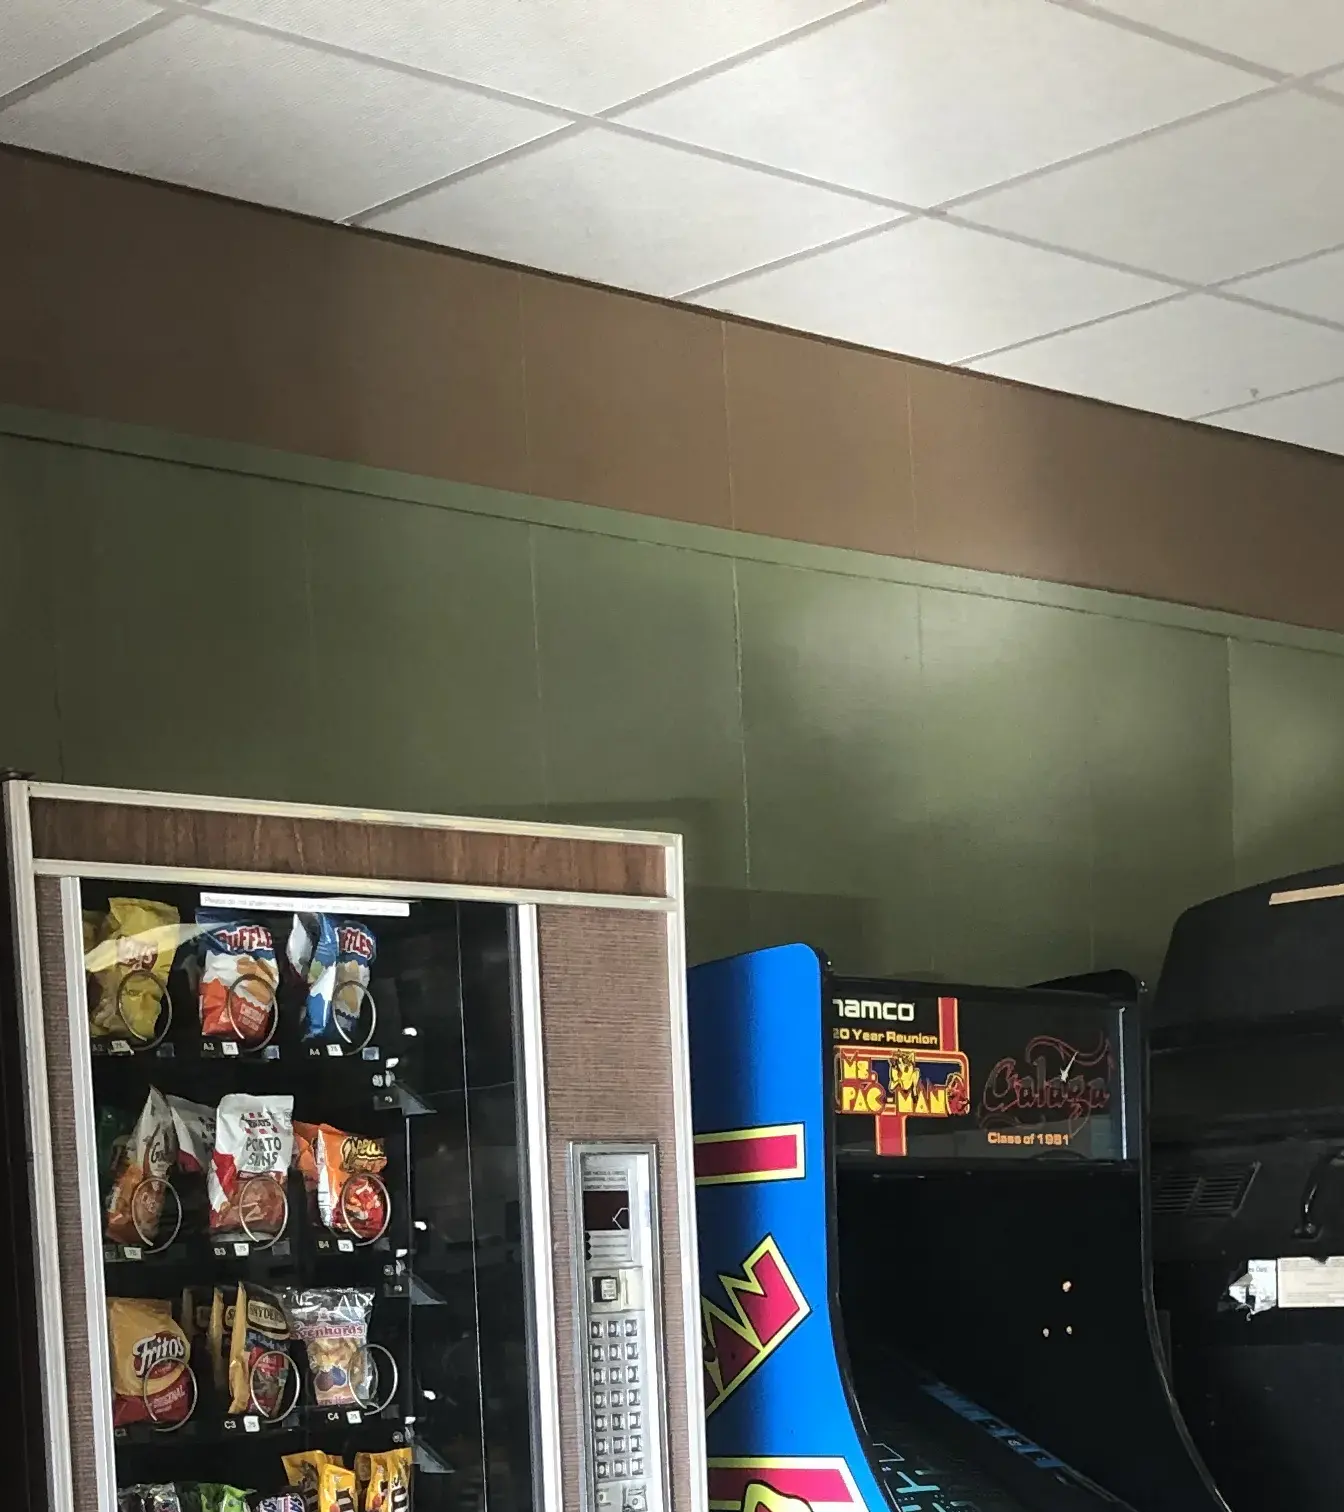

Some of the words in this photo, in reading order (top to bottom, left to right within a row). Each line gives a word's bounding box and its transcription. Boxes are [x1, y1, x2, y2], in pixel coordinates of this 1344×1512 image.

[852, 1028, 885, 1042] Year
[886, 1030, 938, 1045] Reunion
[842, 1086, 946, 1114] PAC-MAN
[987, 1131, 1021, 1145] Class
[1022, 1133, 1035, 1145] of
[1037, 1133, 1070, 1146] 1981
[132, 1333, 185, 1377] Fritos
